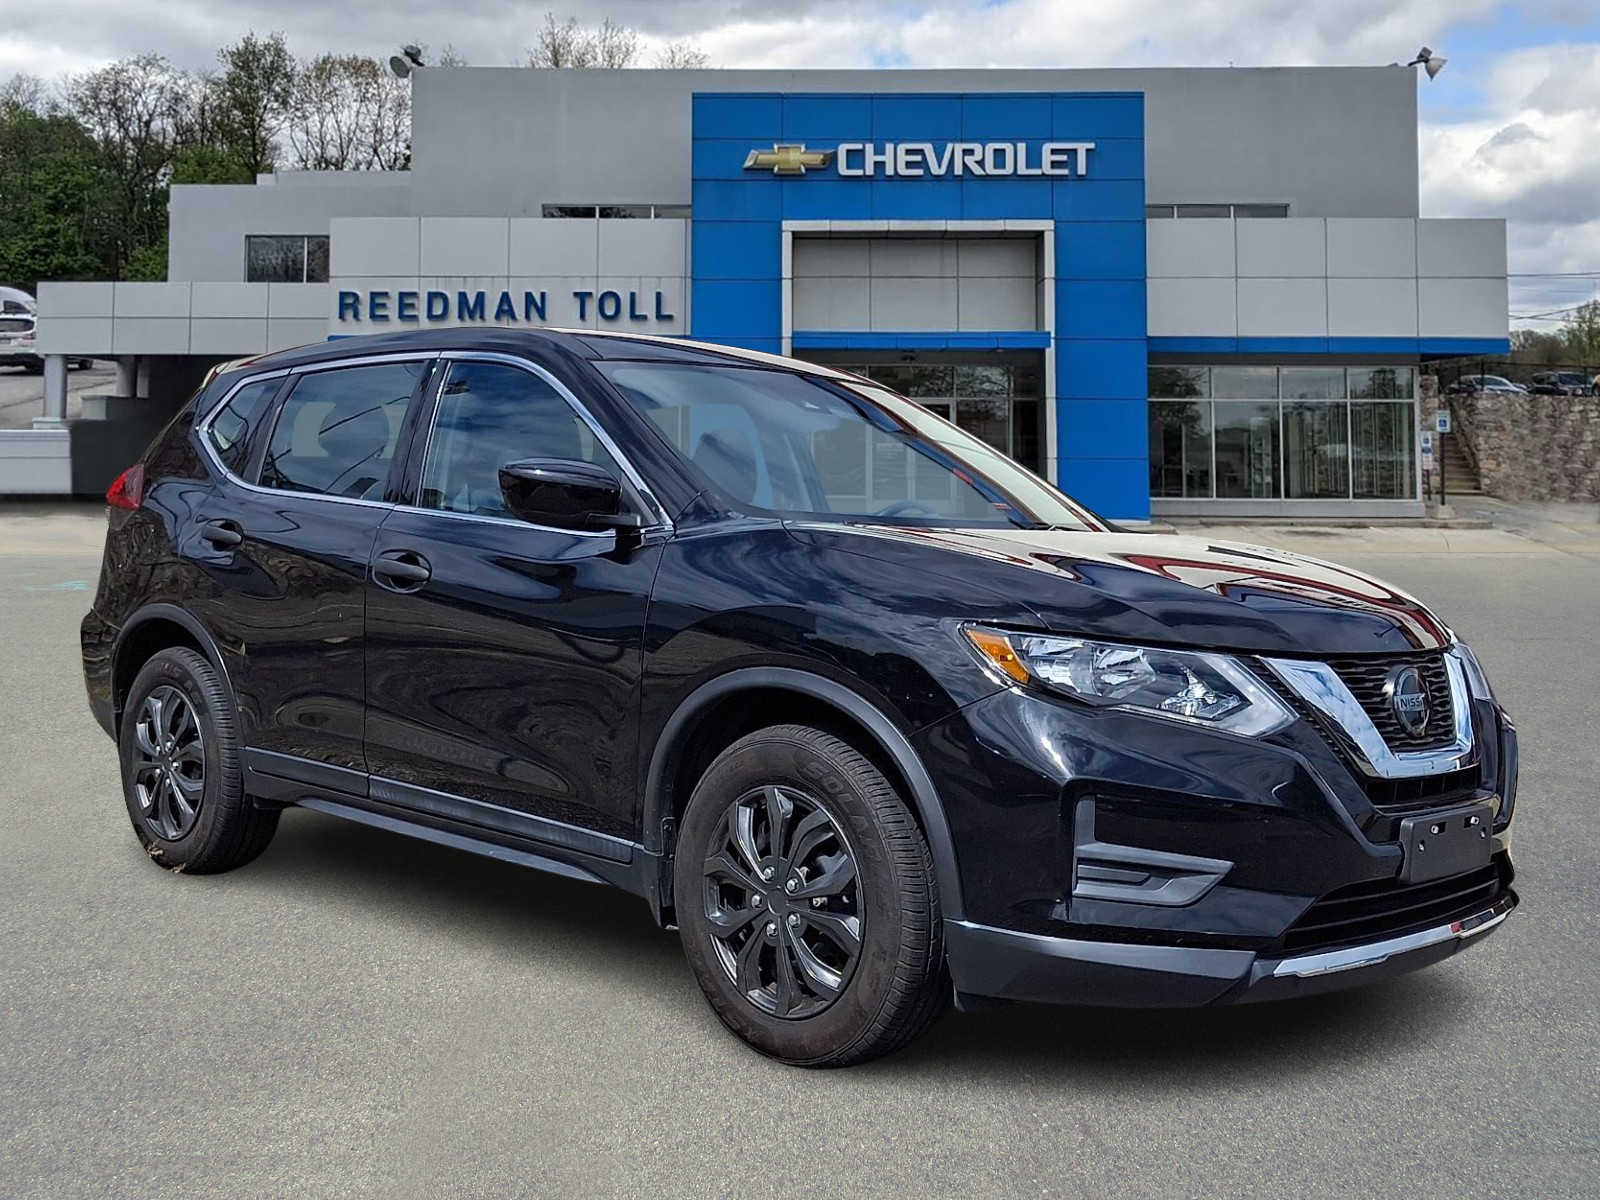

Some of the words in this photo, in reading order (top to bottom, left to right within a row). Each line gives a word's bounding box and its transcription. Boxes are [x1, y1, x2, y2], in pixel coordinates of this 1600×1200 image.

[837, 142, 1096, 177] CHEVROLET
[338, 291, 548, 321] REEDMAN
[572, 291, 674, 321] TOLL
